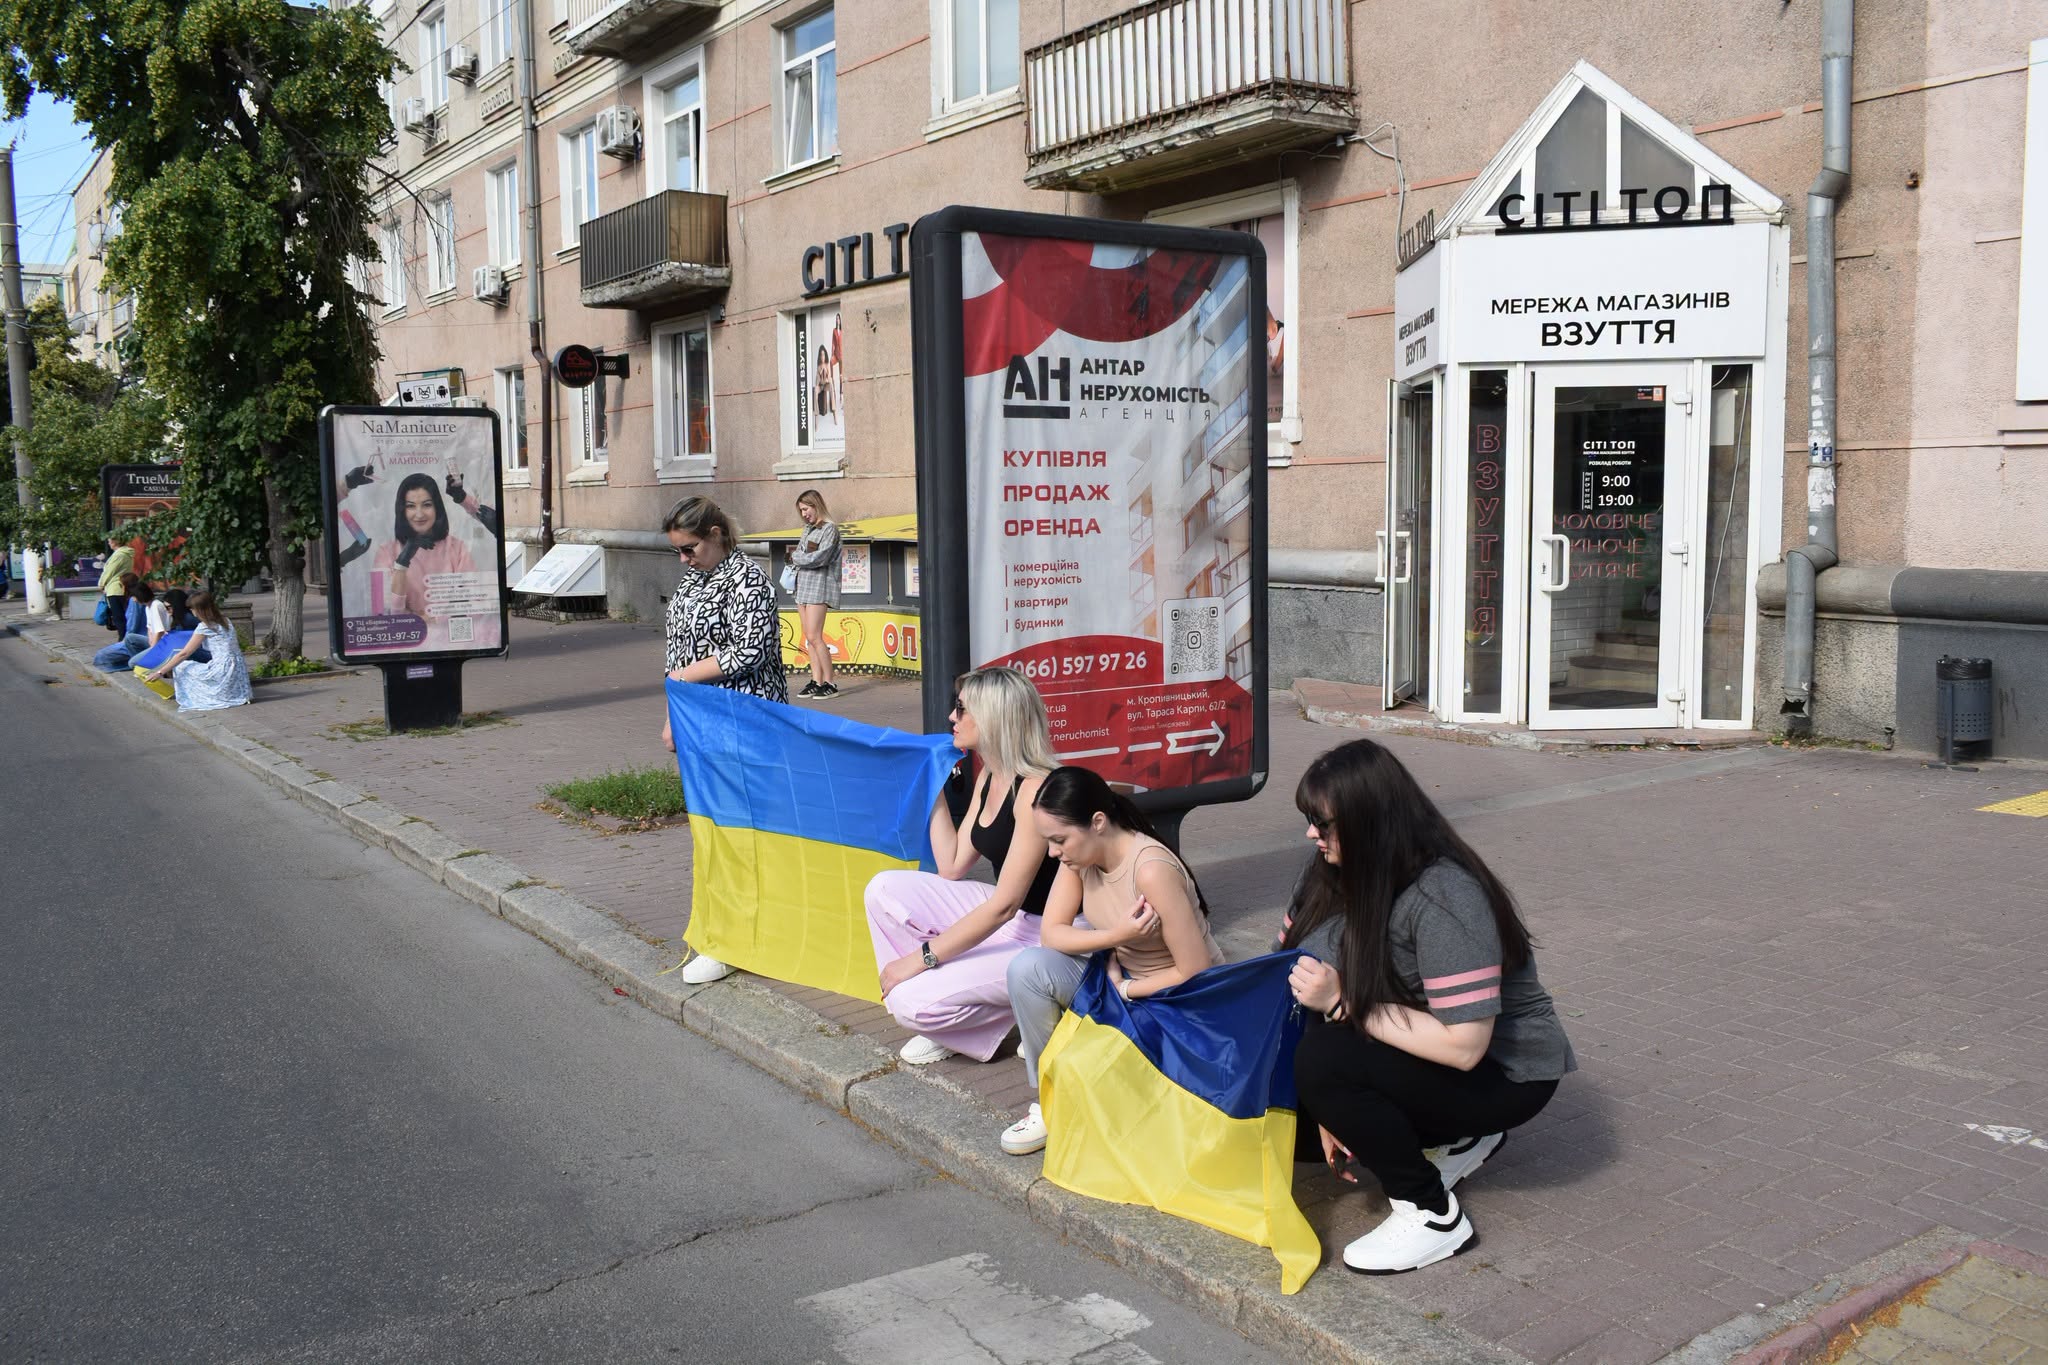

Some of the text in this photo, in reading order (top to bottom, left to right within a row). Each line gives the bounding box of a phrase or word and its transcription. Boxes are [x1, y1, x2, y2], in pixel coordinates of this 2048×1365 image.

[1499, 184, 1732, 228] СІТІ ТОП
[1416, 208, 1435, 249] ТОП
[802, 222, 910, 293] СІТІ Т
[1491, 292, 1731, 315] МЕРЕЖА МАГАЗИНІВ
[1541, 319, 1675, 347] ВЗУТТЯ
[1406, 335, 1427, 367] ВЗУТТЯ
[1080, 358, 1145, 376] АНТАР
[1003, 355, 1071, 402] АН
[1080, 385, 1211, 403] НЕРУХОМІСТЬ
[1080, 407, 1211, 422] АГЕНЦІЯ
[362, 420, 457, 433] NaManicure
[1583, 440, 1636, 450] СІТІ ТОП
[389, 456, 440, 465] МАНІКЮРУ
[1003, 450, 1107, 468] КУПІВЛЯ
[1602, 475, 1631, 487] 9:00
[1003, 484, 1110, 505] ПРОДАЖ
[1598, 494, 1635, 506] 19:00
[1004, 518, 1102, 538] ОРЕНДА
[1472, 424, 1501, 636] ВЗУТТЯ
[1553, 513, 1657, 530] ЧОЛОВІЧЕ
[1013, 559, 1079, 573] комерційна
[1014, 573, 1082, 588] нерухомість
[1014, 597, 1068, 610] квартири
[1014, 618, 1064, 632] будинки
[356, 631, 421, 643] 095-321-97-57
[1062, 655, 1094, 675] 597
[1099, 653, 1121, 672] 97
[1125, 650, 1148, 670] 26
[1138, 689, 1210, 706] Кропивницький,
[1044, 704, 1067, 713] kr.ua
[1127, 700, 1226, 721] вул. Тараса Карпи, 62/2
[1049, 727, 1110, 742] .neruchomist
